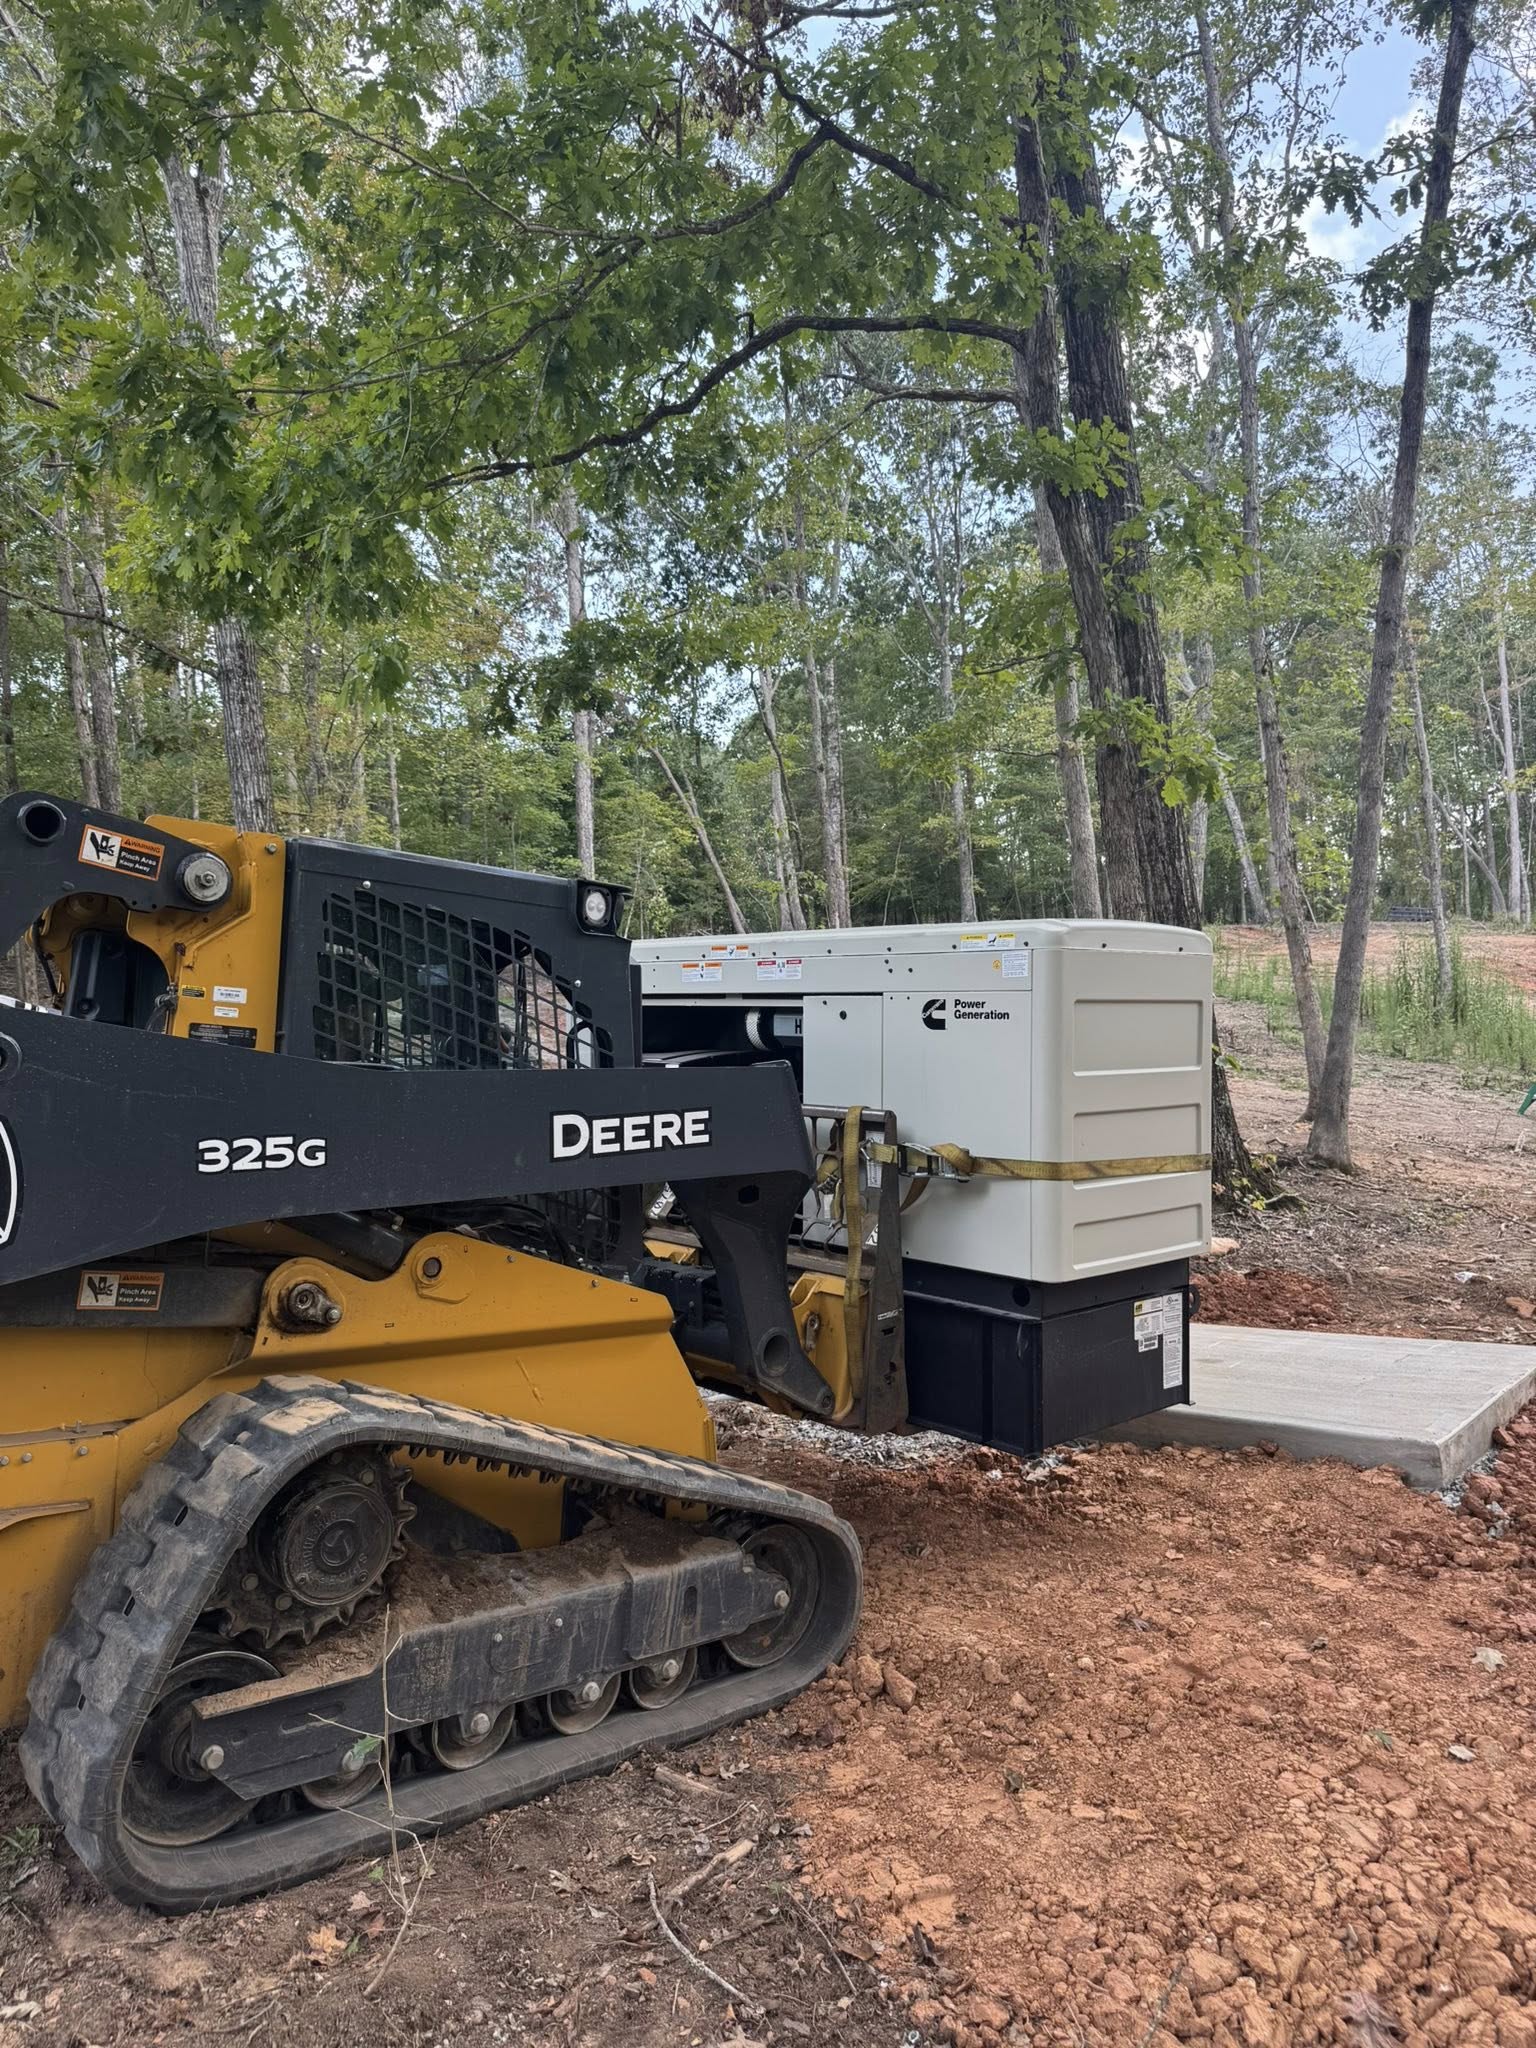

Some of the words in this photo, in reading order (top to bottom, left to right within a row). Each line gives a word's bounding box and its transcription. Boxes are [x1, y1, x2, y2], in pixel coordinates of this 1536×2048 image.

[130, 840, 161, 855] WARNING
[121, 851, 140, 862] Pinch
[141, 856, 157, 866] Area
[120, 860, 134, 869] Keep
[134, 863, 151, 873] Away
[954, 999, 986, 1009] Power
[954, 1009, 1010, 1020] Generation
[553, 1110, 709, 1158] DEERE
[198, 1136, 326, 1173] 325G
[119, 1287, 139, 1295] Pinch
[140, 1287, 157, 1296] Area
